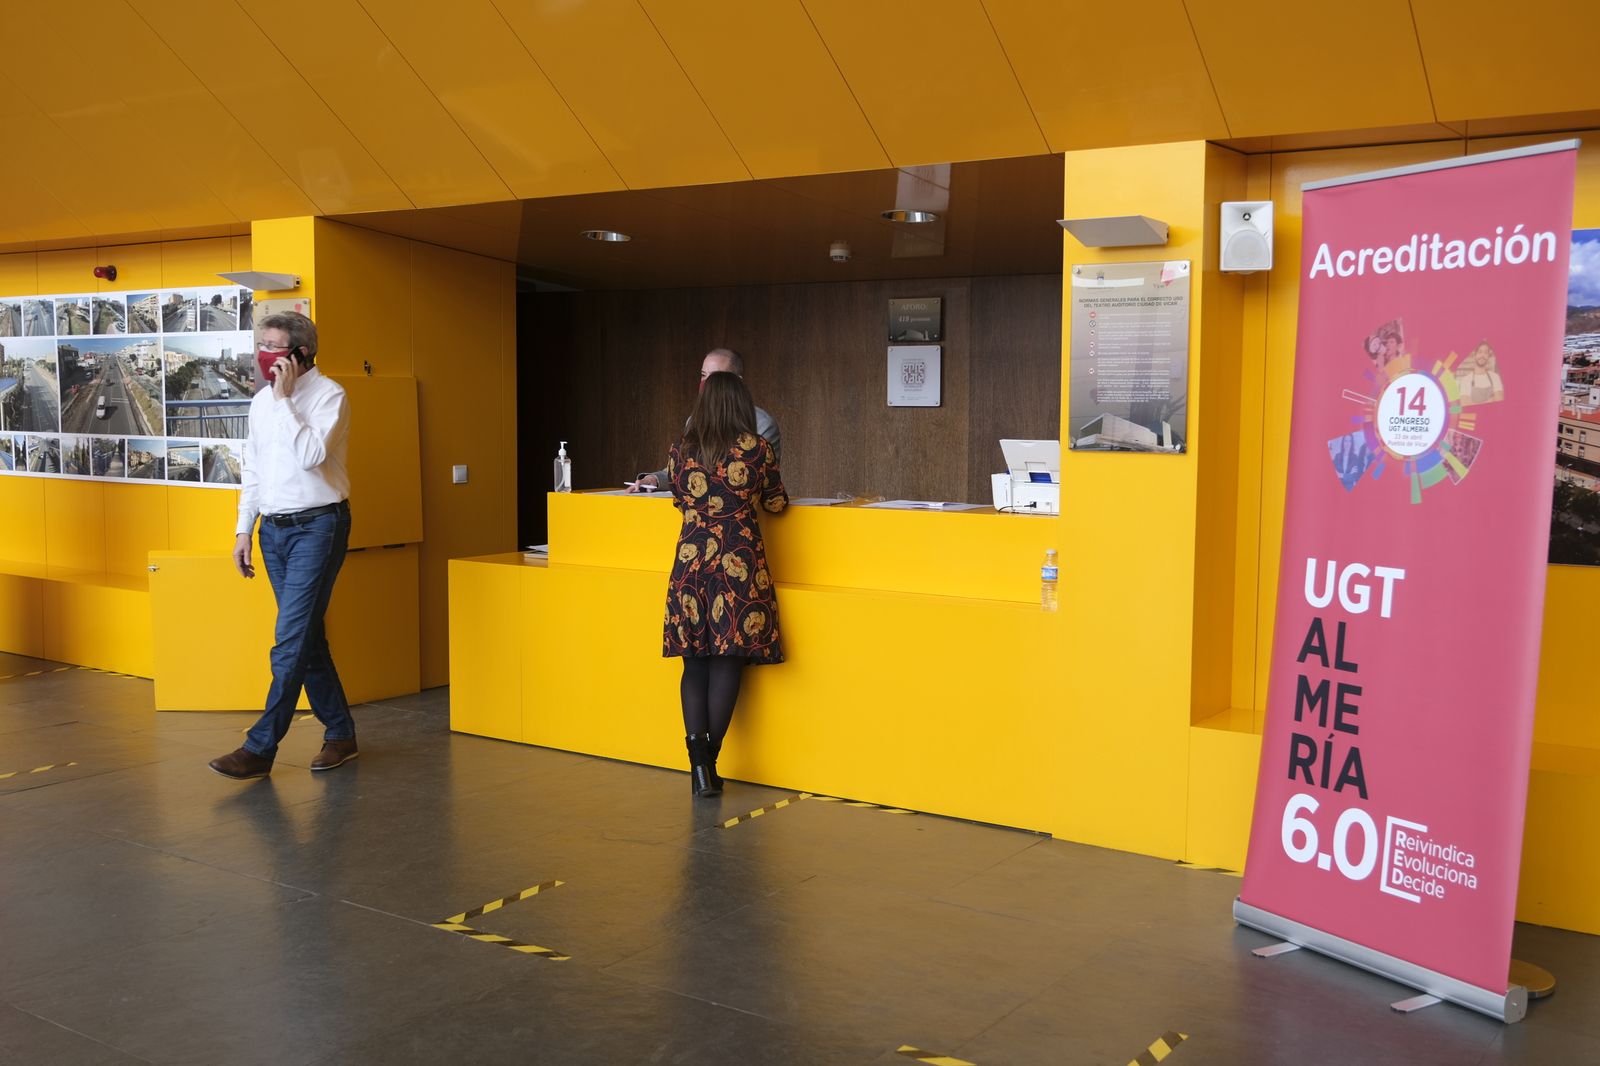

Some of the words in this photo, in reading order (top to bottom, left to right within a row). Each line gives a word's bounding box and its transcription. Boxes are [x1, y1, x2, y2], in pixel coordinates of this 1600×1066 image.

[1309, 224, 1556, 279] Acreditación
[1389, 417, 1430, 425] CONGRESO
[1396, 387, 1426, 416] 14
[1304, 558, 1406, 618] UGT
[1296, 617, 1358, 673] AL
[1294, 674, 1363, 735] ME
[1288, 732, 1368, 800] RÍA
[1281, 793, 1379, 881] 6.0
[1395, 830, 1475, 868] Reivindica
[1391, 868, 1445, 899] Decide
[1393, 850, 1477, 889] Evoluciona
